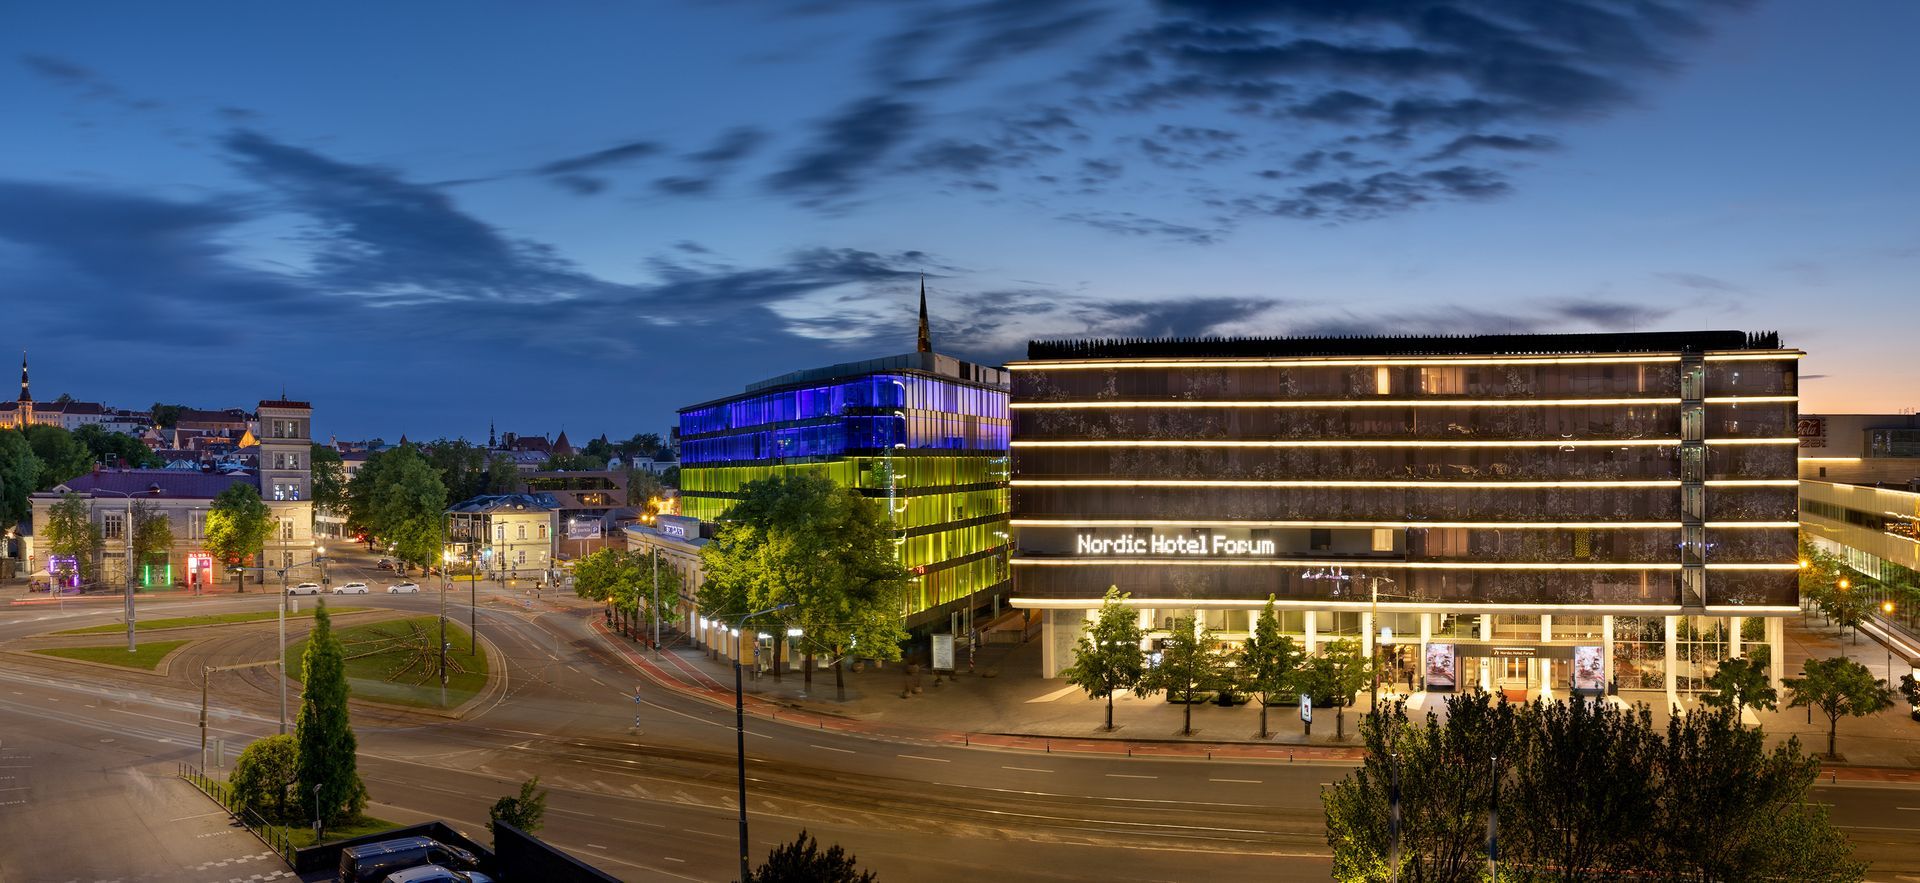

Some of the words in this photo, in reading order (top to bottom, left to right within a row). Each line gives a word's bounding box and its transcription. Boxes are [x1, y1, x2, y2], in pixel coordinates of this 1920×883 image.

[1078, 534, 1147, 554] Nordic
[1151, 534, 1208, 554] Hotel
[1213, 535, 1275, 554] Forum
